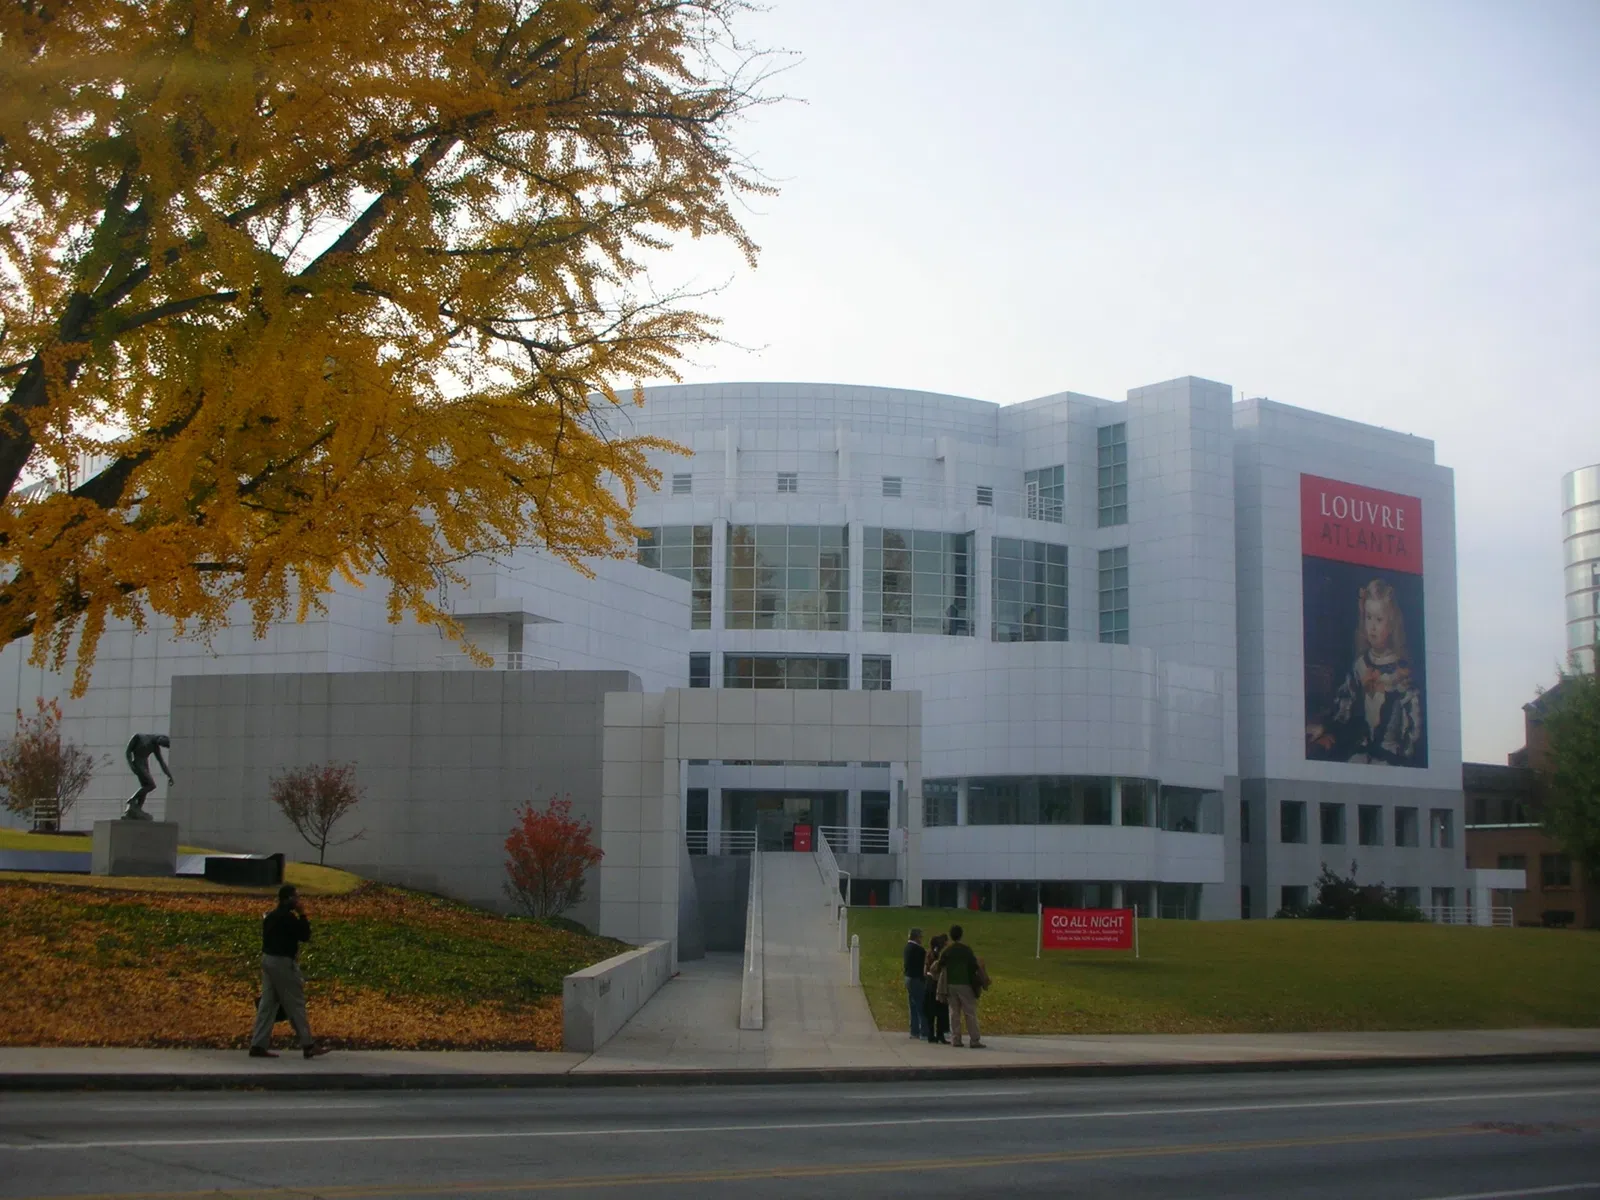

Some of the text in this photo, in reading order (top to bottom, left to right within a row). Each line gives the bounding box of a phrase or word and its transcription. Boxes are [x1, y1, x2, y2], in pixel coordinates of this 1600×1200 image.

[1320, 492, 1405, 531] LOUVRE
[1321, 522, 1408, 556] ATLANTA
[1051, 915, 1124, 928] GO ALL NIGHT
